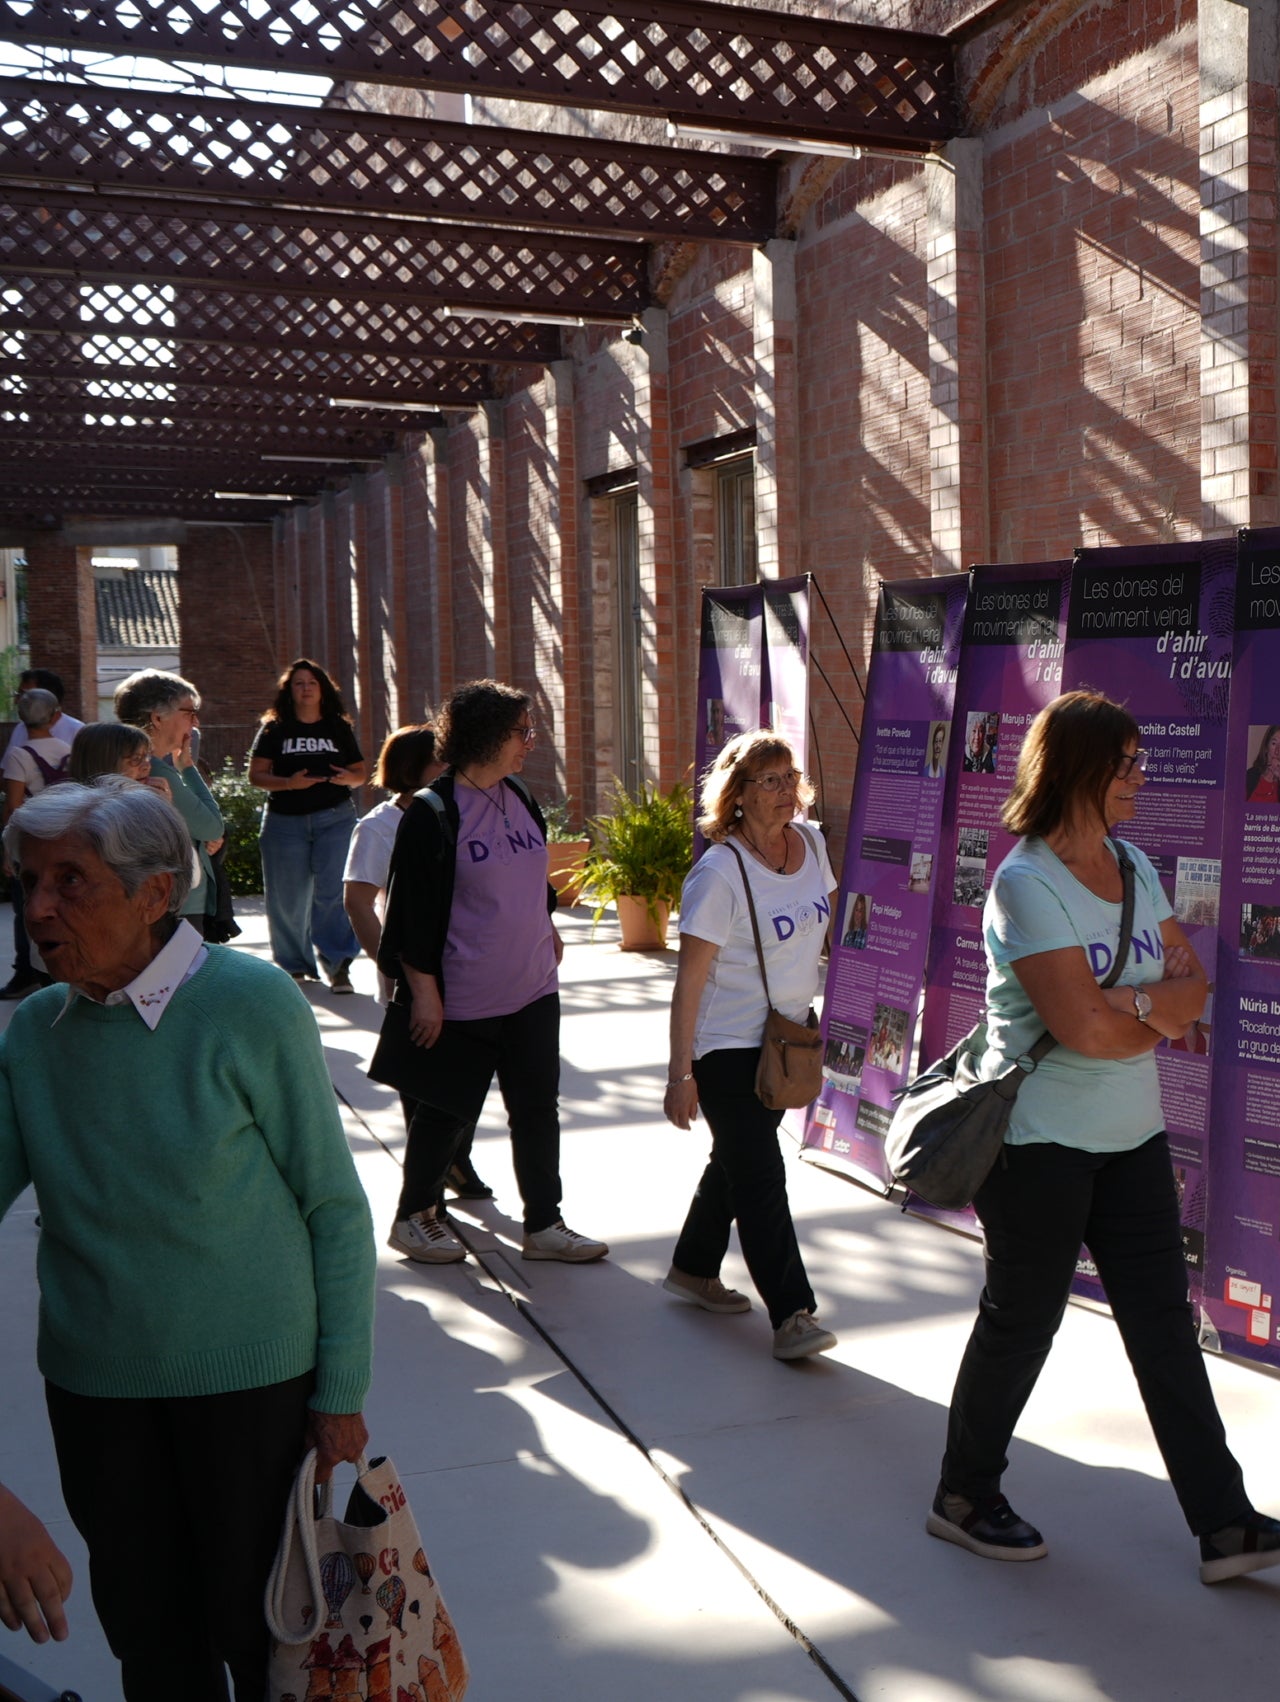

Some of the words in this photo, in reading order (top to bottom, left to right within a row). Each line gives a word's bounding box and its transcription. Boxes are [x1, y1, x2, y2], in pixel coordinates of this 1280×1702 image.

[1251, 562, 1280, 585] Les
[1169, 723, 1200, 736] Castell
[1239, 996, 1268, 1013] Núria
[1238, 1039, 1249, 1050] un
[1249, 1040, 1269, 1056] grup
[1269, 1043, 1280, 1056] de
